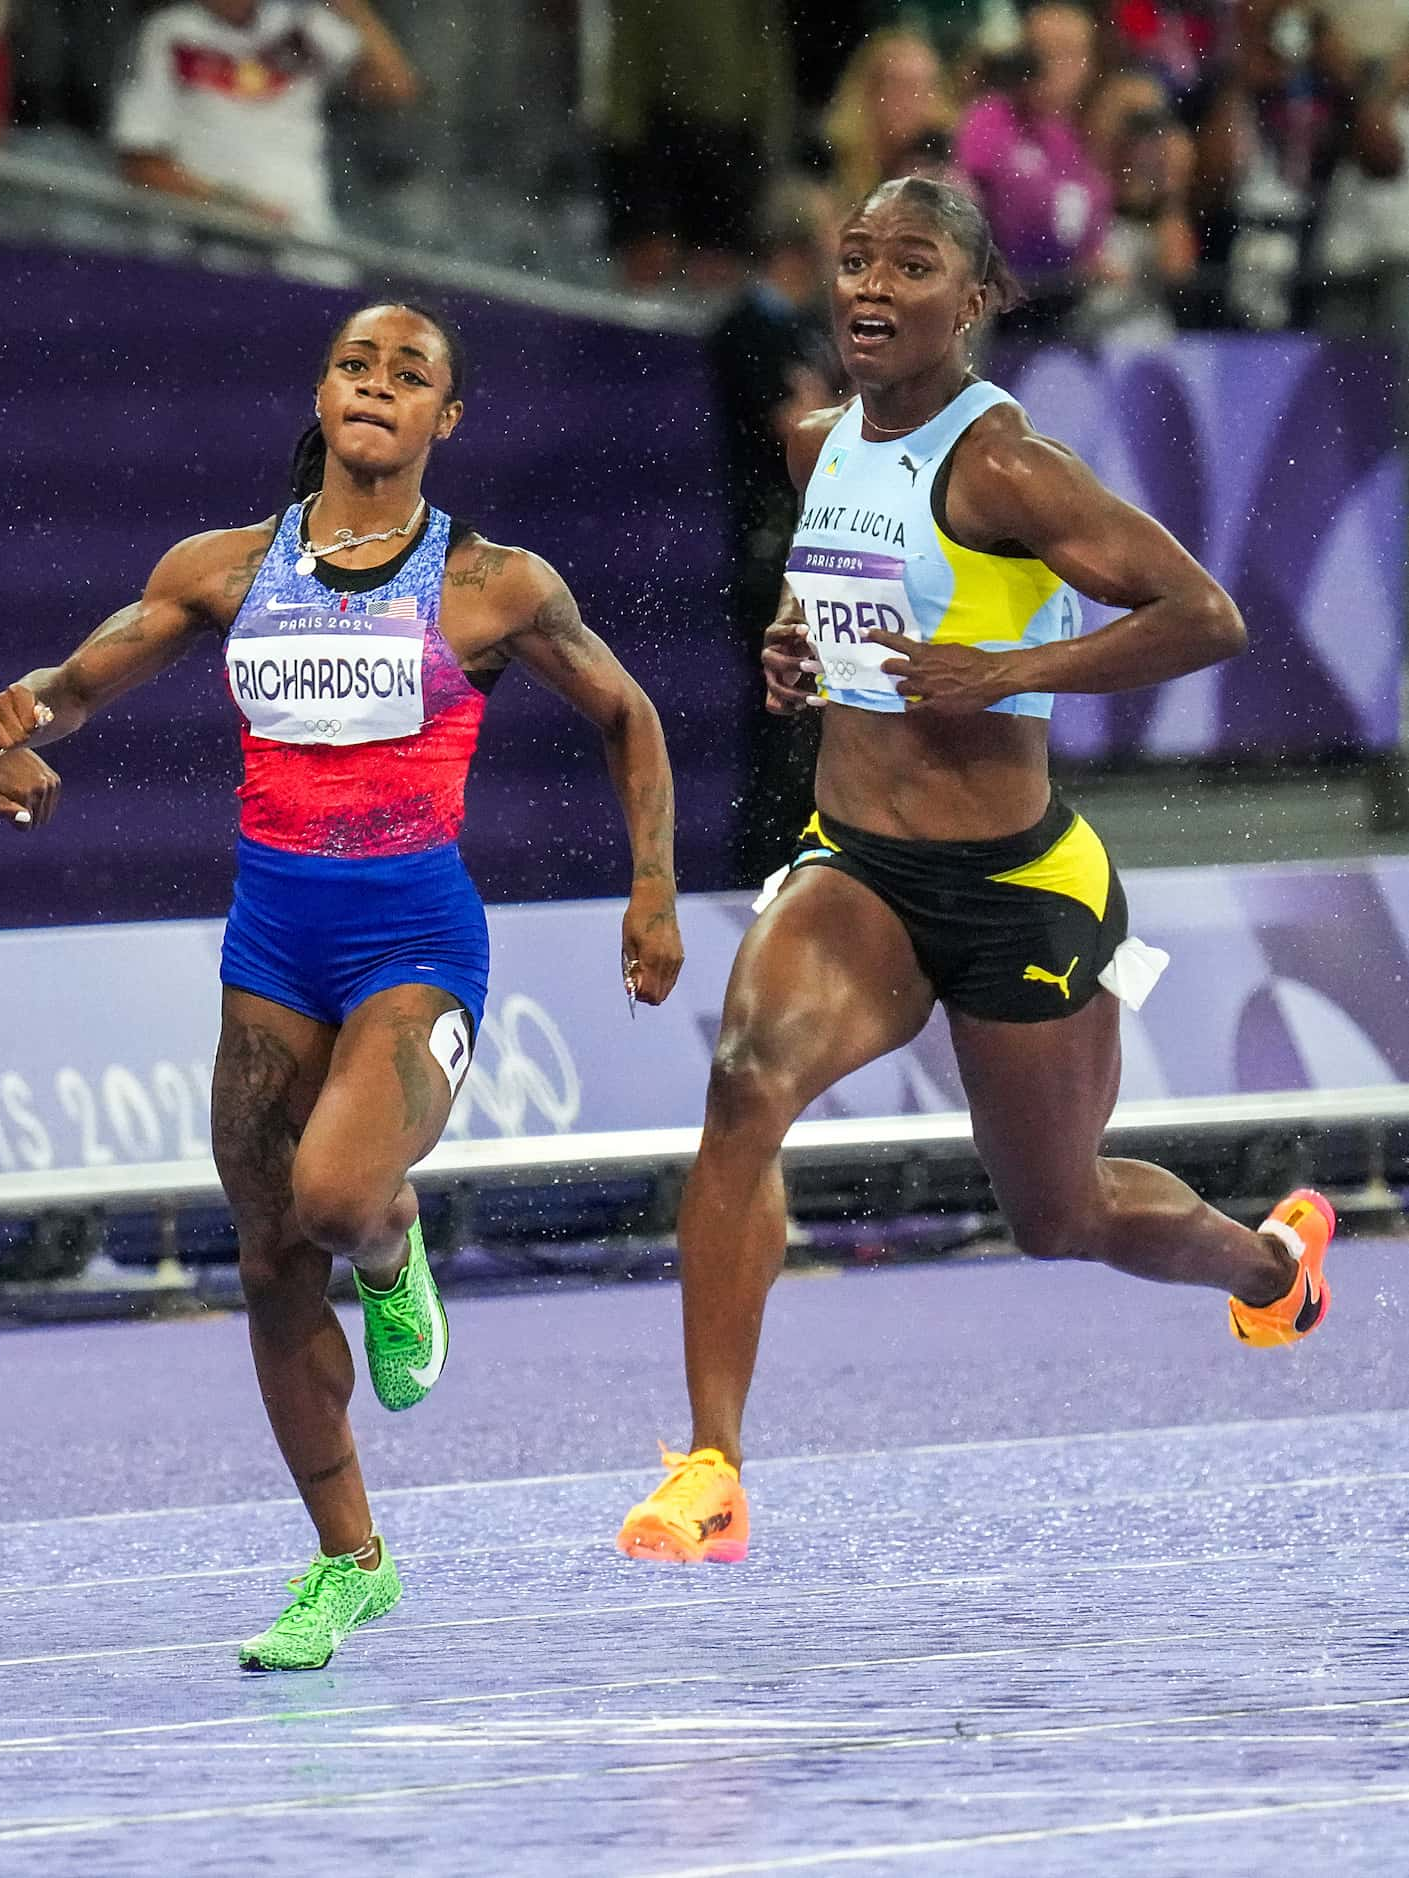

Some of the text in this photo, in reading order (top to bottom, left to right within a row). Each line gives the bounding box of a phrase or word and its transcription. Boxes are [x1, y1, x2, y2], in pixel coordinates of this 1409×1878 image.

[850, 508, 905, 548] LUCIA
[806, 553, 863, 571] PARIS 2024
[279, 617, 374, 632] PARIS 2024
[800, 599, 906, 645] FRED
[234, 657, 416, 701] RICHARDSON
